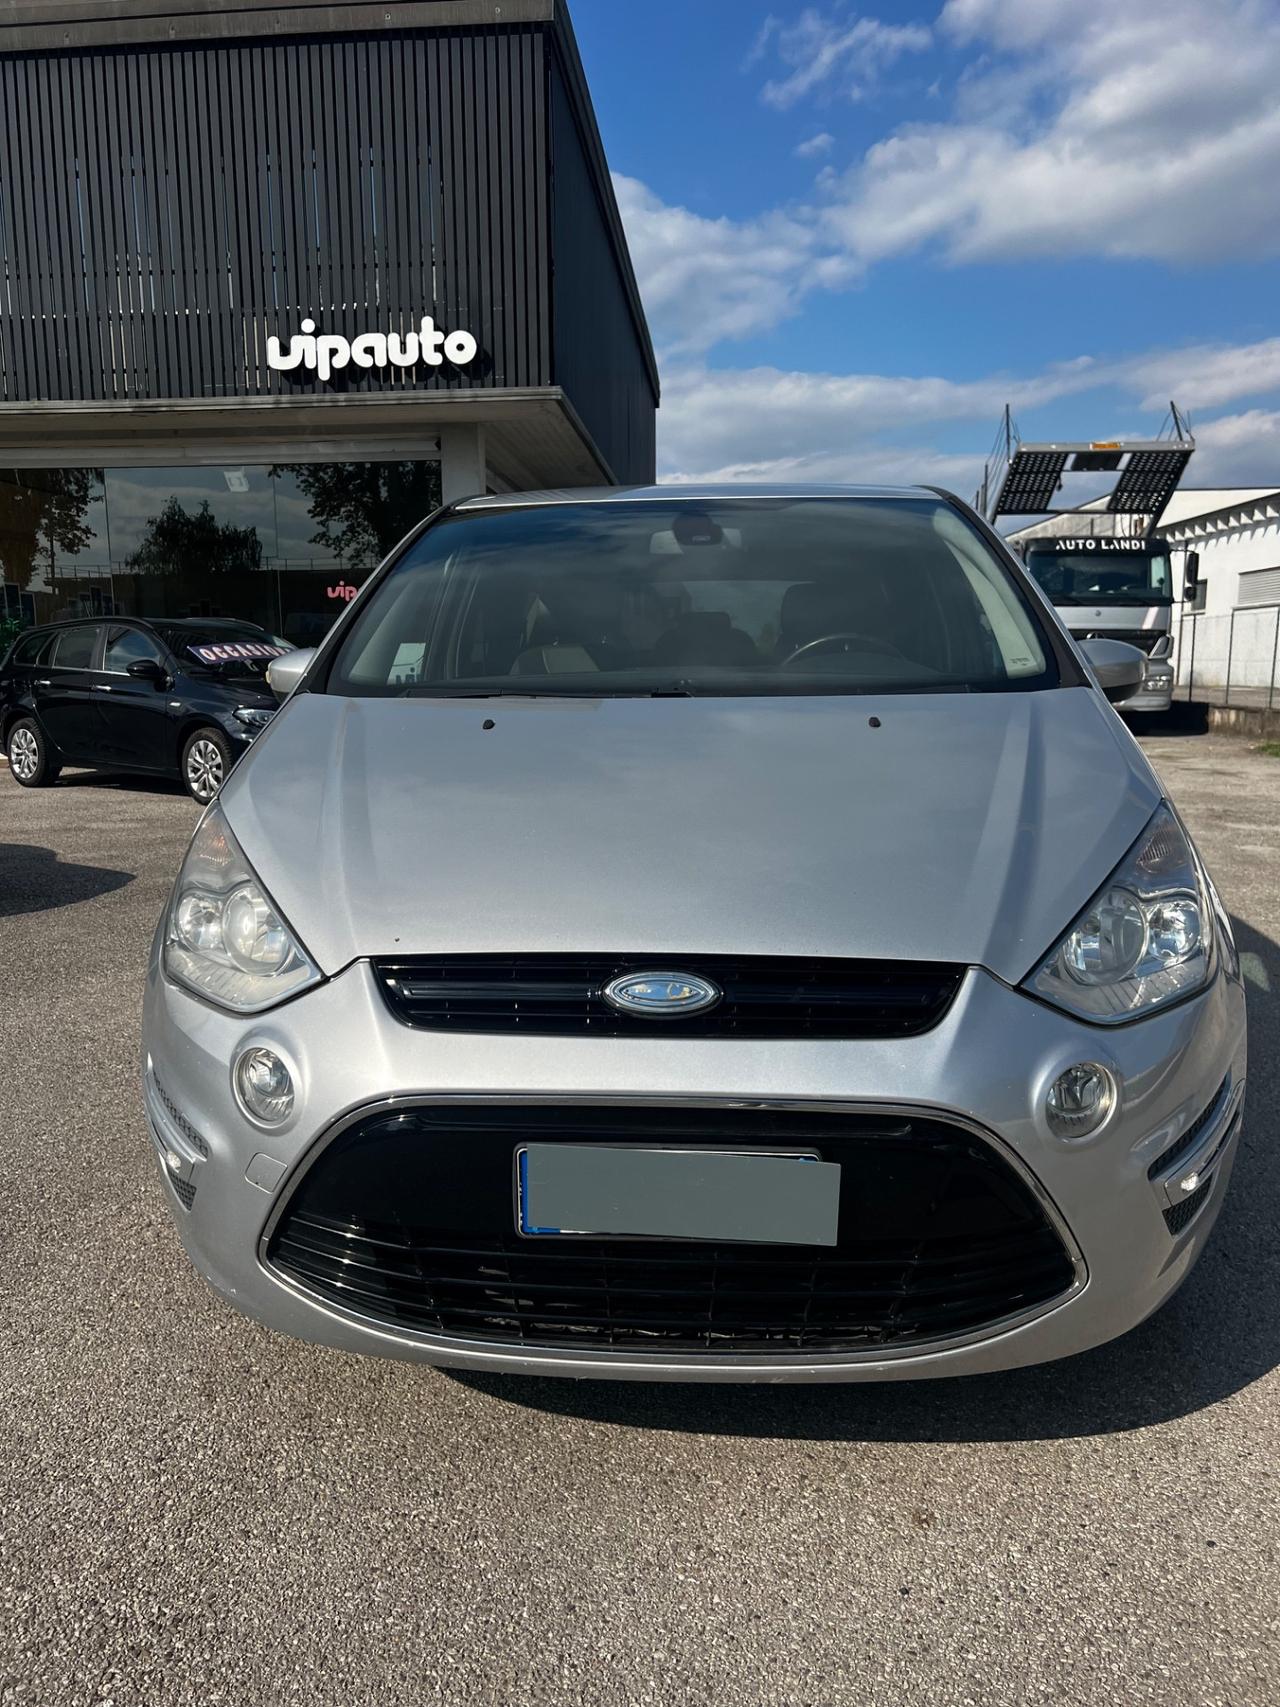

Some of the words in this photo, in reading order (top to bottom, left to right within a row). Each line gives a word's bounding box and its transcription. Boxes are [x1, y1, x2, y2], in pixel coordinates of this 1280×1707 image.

[267, 315, 478, 381] vipauto
[1055, 539, 1096, 550] AUTO
[1101, 539, 1145, 550] LANDI
